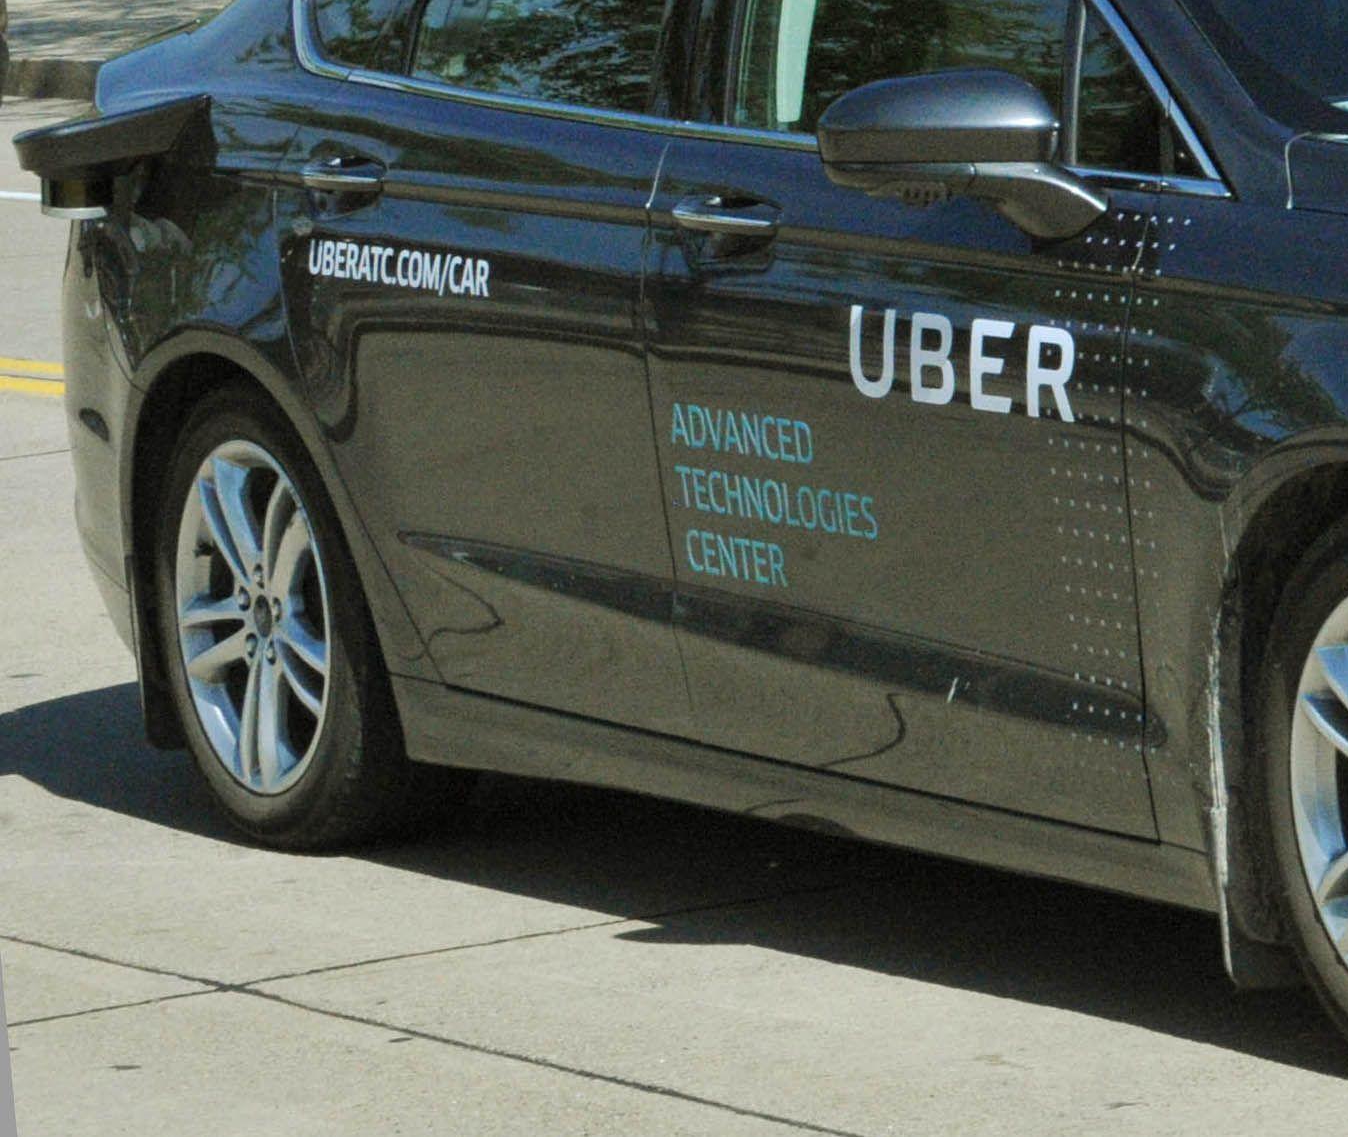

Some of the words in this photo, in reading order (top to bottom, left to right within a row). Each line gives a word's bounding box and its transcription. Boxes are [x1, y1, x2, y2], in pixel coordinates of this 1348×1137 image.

[308, 239, 490, 297] UBERATC.COM/CAR
[849, 304, 1076, 423] UBER
[671, 402, 813, 464] ADVANCED
[673, 463, 880, 541] TECHNOLOGIES
[685, 528, 788, 587] CENTER
